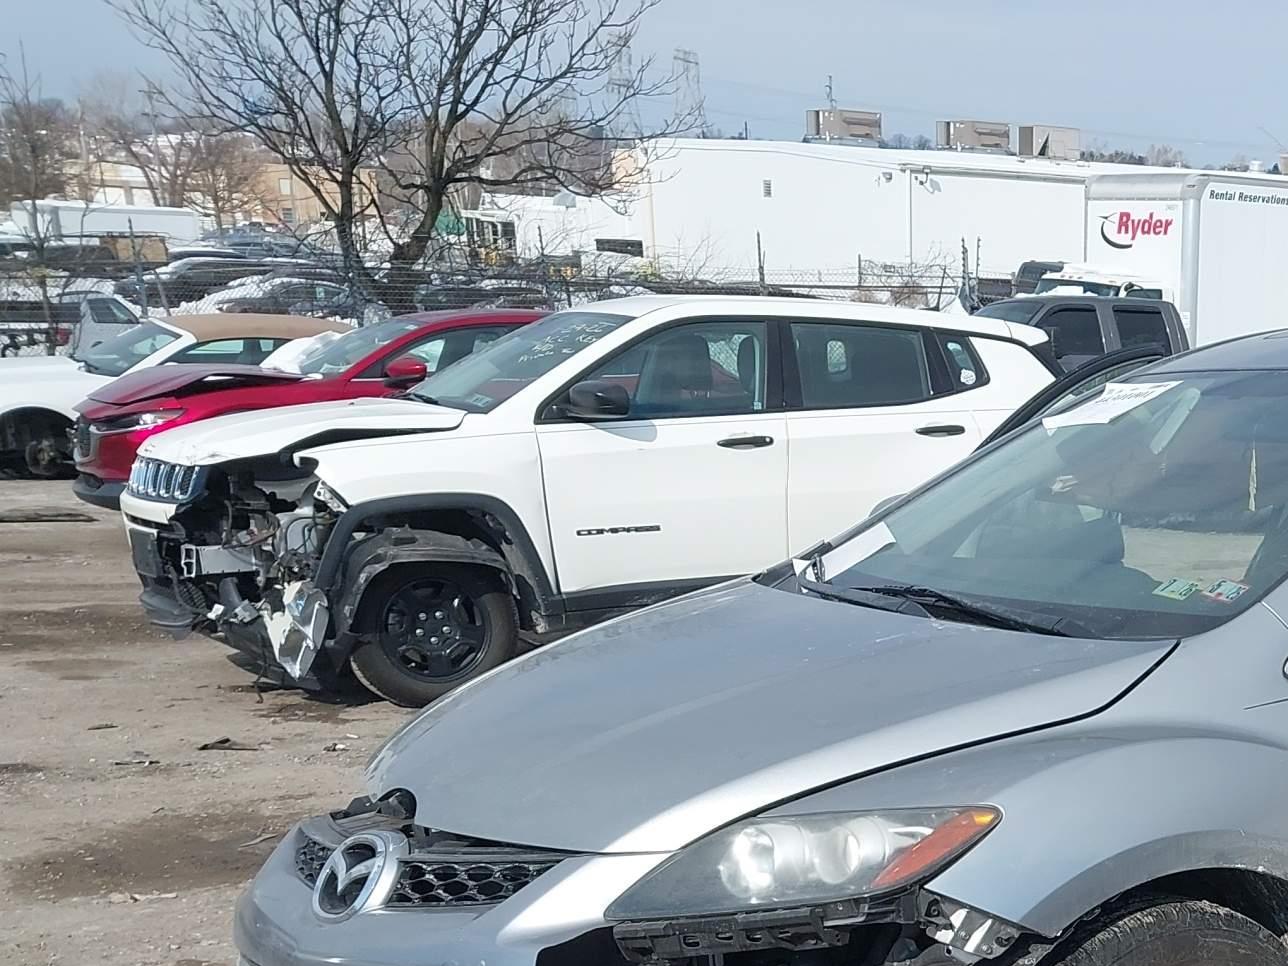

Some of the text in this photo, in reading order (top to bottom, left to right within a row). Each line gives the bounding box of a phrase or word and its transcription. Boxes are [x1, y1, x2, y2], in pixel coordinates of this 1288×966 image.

[1209, 189, 1236, 201] Rental
[1117, 211, 1174, 241] Ryder
[576, 525, 661, 537] COMPASS
